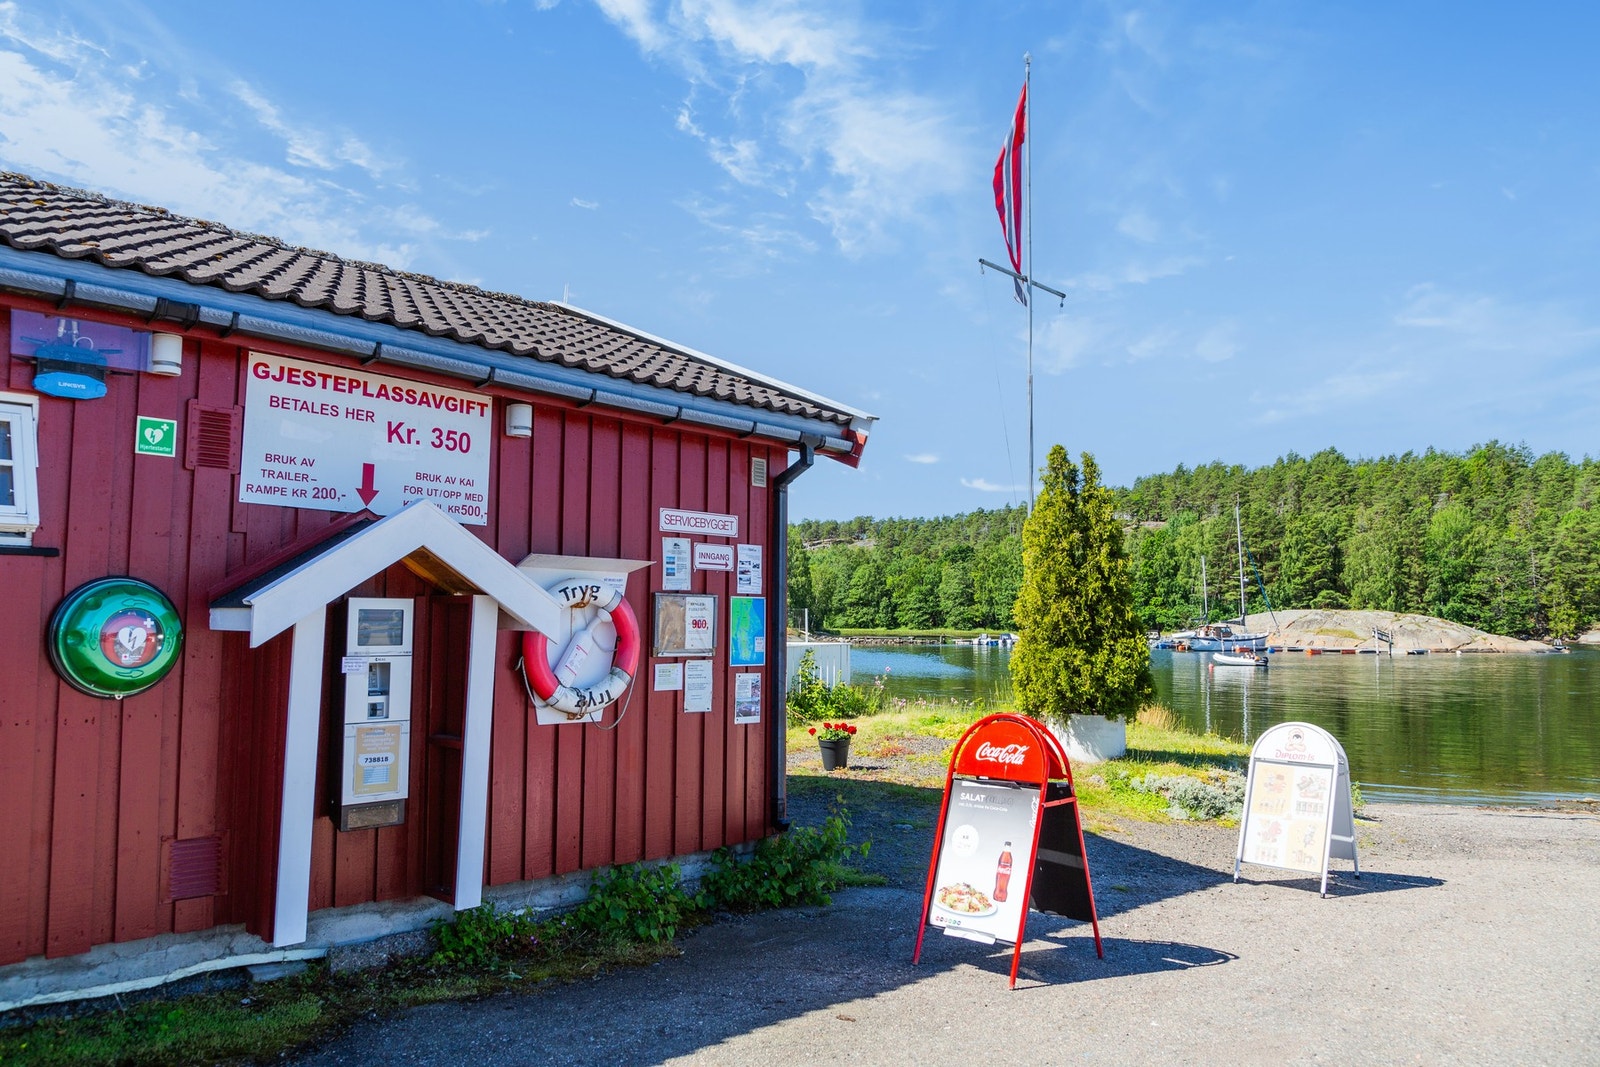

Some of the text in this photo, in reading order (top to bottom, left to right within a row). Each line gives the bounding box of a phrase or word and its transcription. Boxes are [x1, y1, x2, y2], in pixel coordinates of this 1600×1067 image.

[58, 381, 86, 389] LINKSYS
[253, 362, 488, 417] GJESTEPLASSAVGIFT
[269, 395, 375, 423] BETALES HER
[387, 421, 471, 454] Kr. 350
[265, 453, 315, 467] BRUK AV
[415, 472, 474, 487] BRUK AV KAI
[246, 484, 346, 502] RAMPE KR 200,-
[403, 485, 484, 502] FOR UT/OPP MED
[664, 513, 734, 531] SERVICEBYGGET
[698, 552, 730, 562] INNGANG
[559, 585, 601, 602] Tryg
[975, 741, 1029, 765] Coca-Cola
[960, 792, 986, 803] SALAT
